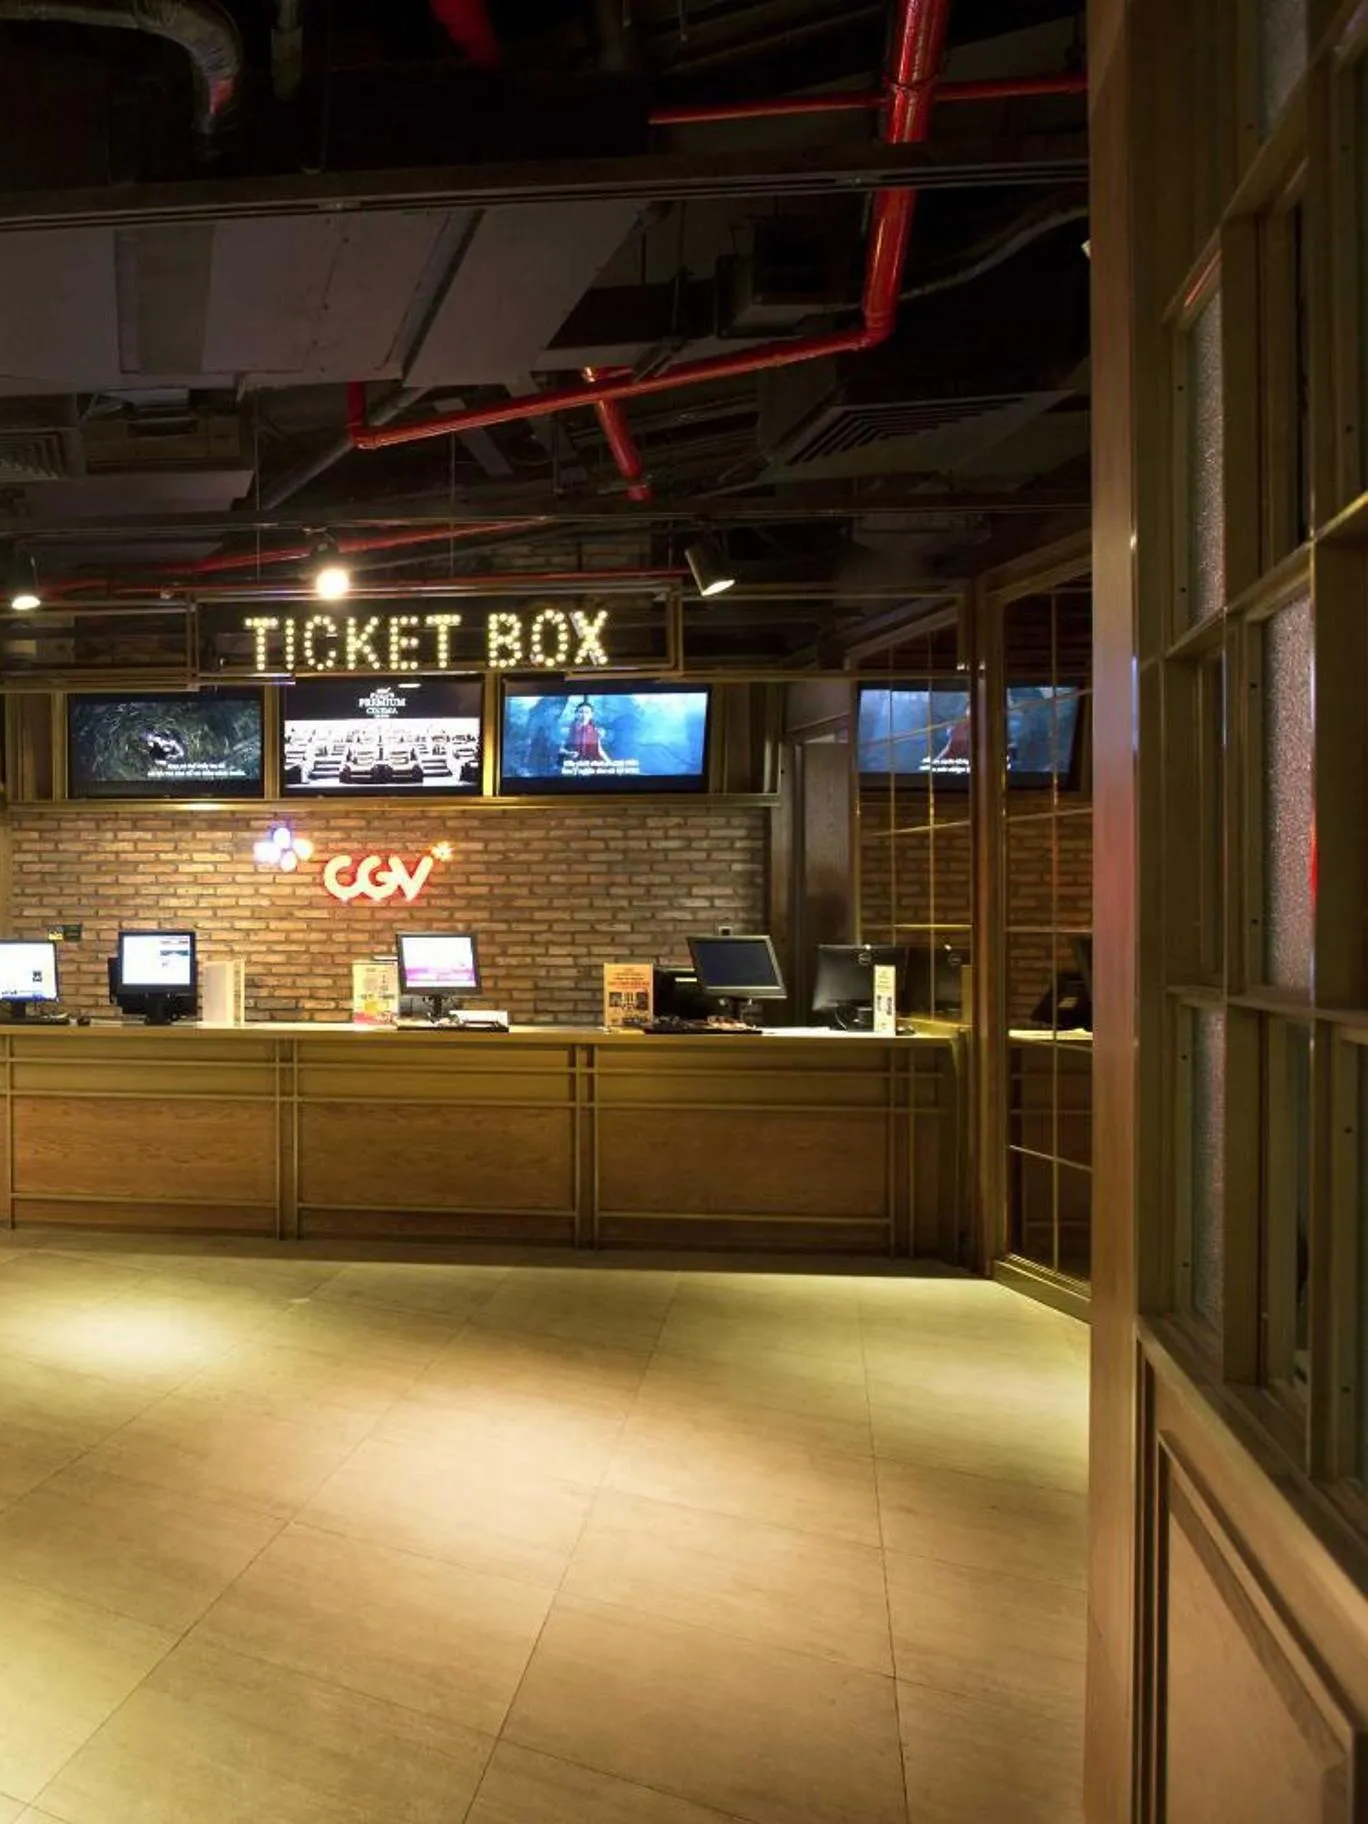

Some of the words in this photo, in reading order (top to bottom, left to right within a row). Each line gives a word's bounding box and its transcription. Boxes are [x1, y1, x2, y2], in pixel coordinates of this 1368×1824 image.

[243, 613, 462, 671] TICKET
[487, 608, 609, 669] BOX
[323, 854, 434, 902] CGV
